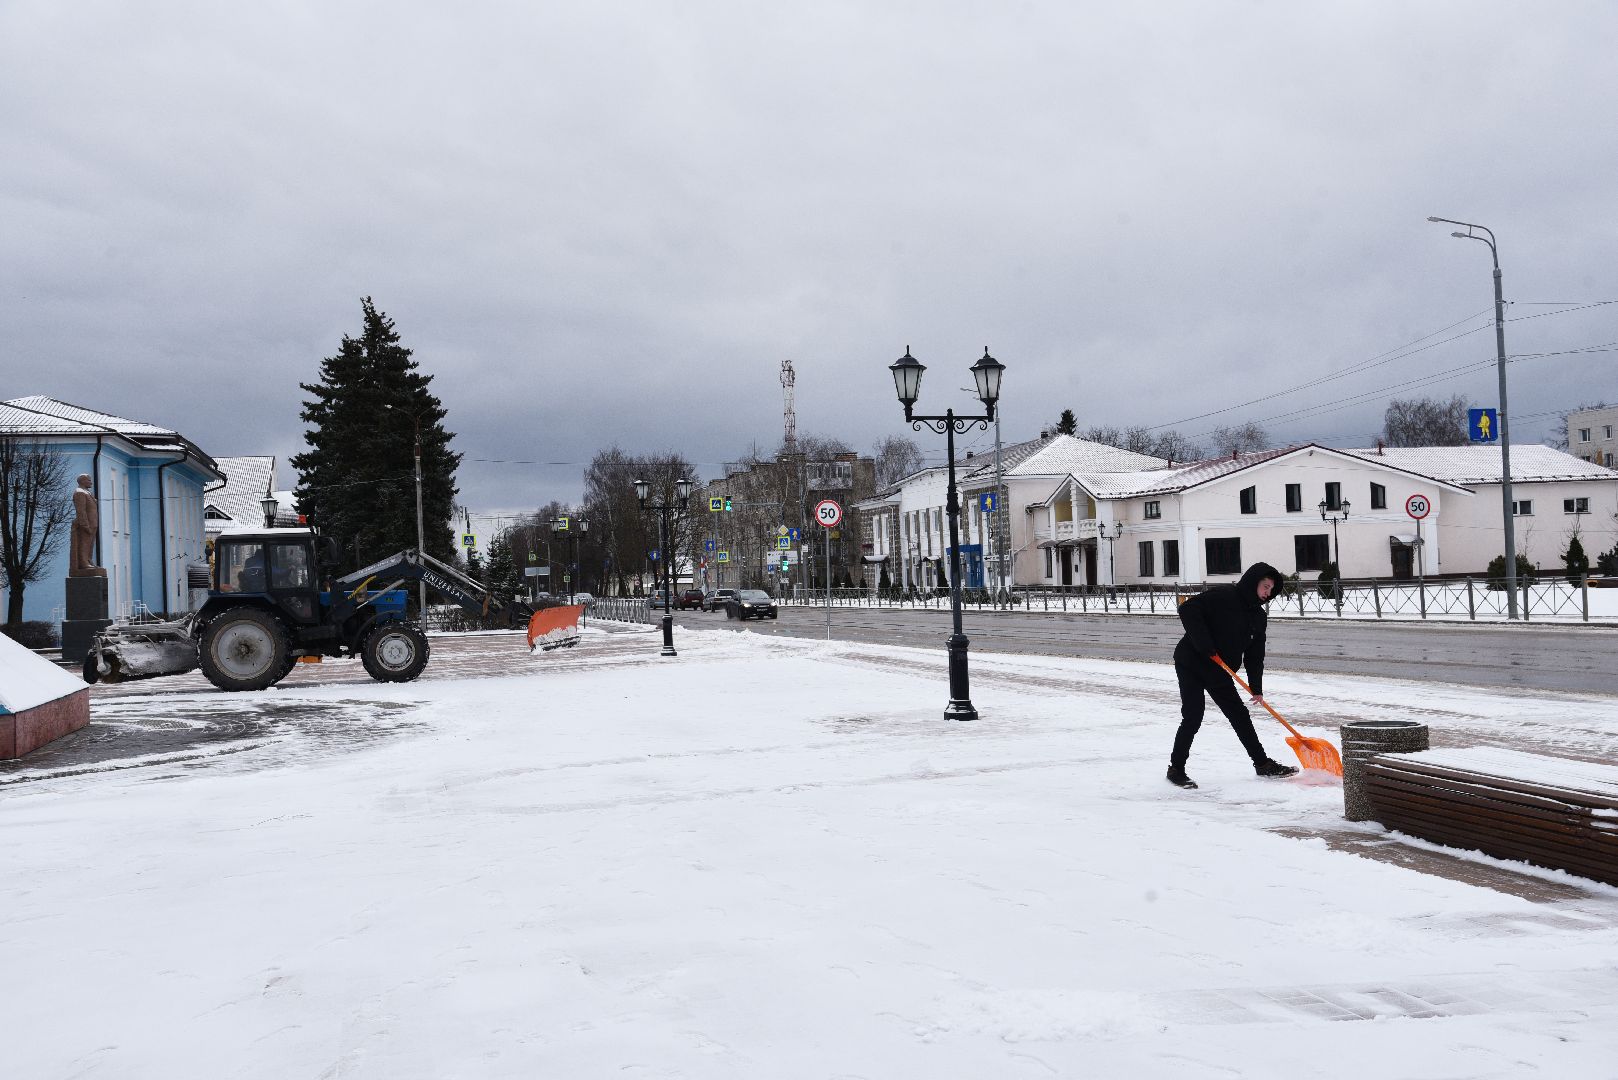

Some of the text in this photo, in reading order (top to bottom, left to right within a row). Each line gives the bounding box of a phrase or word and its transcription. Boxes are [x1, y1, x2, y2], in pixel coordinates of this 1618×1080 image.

[1411, 501, 1425, 512] 50
[820, 507, 836, 519] 50
[423, 571, 464, 600] UNIVERSAL
